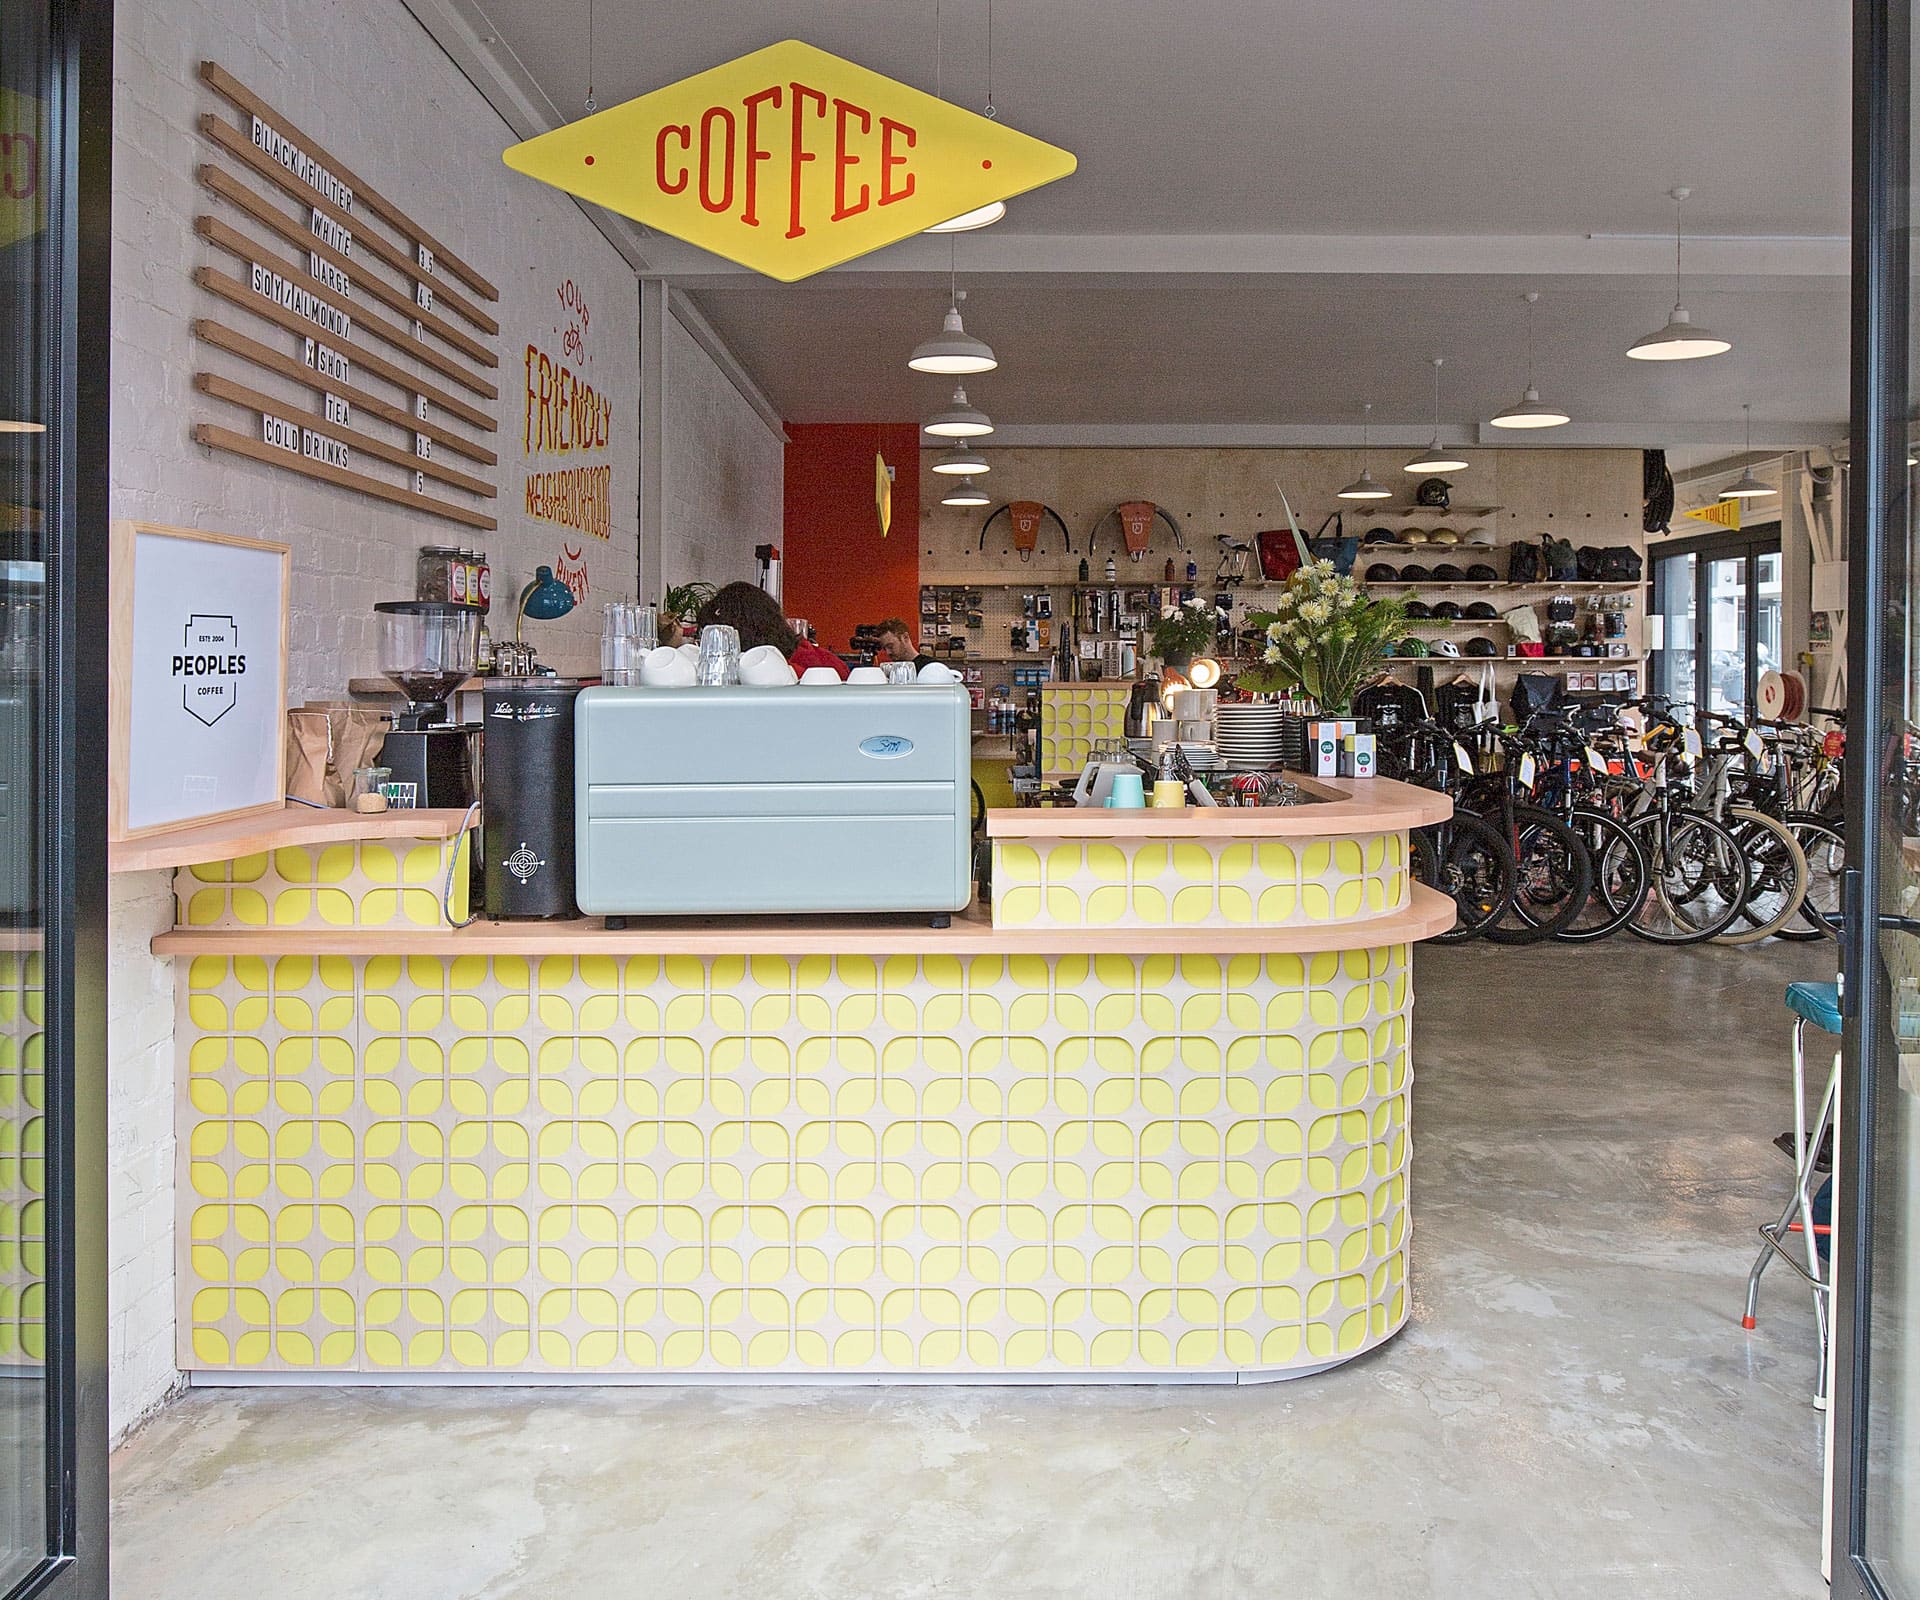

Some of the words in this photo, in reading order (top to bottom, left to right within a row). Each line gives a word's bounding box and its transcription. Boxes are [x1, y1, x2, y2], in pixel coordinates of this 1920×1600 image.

[655, 81, 917, 240] COFFEE
[254, 123, 352, 213] BLACK/FILTER
[420, 250, 433, 273] 3.5
[313, 212, 350, 257] WHITE
[419, 288, 432, 311] 4.5
[254, 268, 350, 338] SOY/ALMOND/
[312, 256, 349, 298] LARGE
[417, 324, 423, 342] 1
[557, 279, 590, 335] YOUR
[306, 344, 314, 367] X
[319, 353, 349, 383] SHOT
[524, 343, 612, 455] FRIENDLY
[327, 399, 349, 426] TEA
[265, 419, 299, 450] COLD
[304, 436, 348, 468] DRINKS
[418, 475, 423, 493] 5
[525, 464, 611, 540] NEIGHBOURHOOD
[1705, 503, 1732, 526] TOILET
[172, 655, 246, 676] PEOPLES
[197, 686, 224, 696] COFFEE
